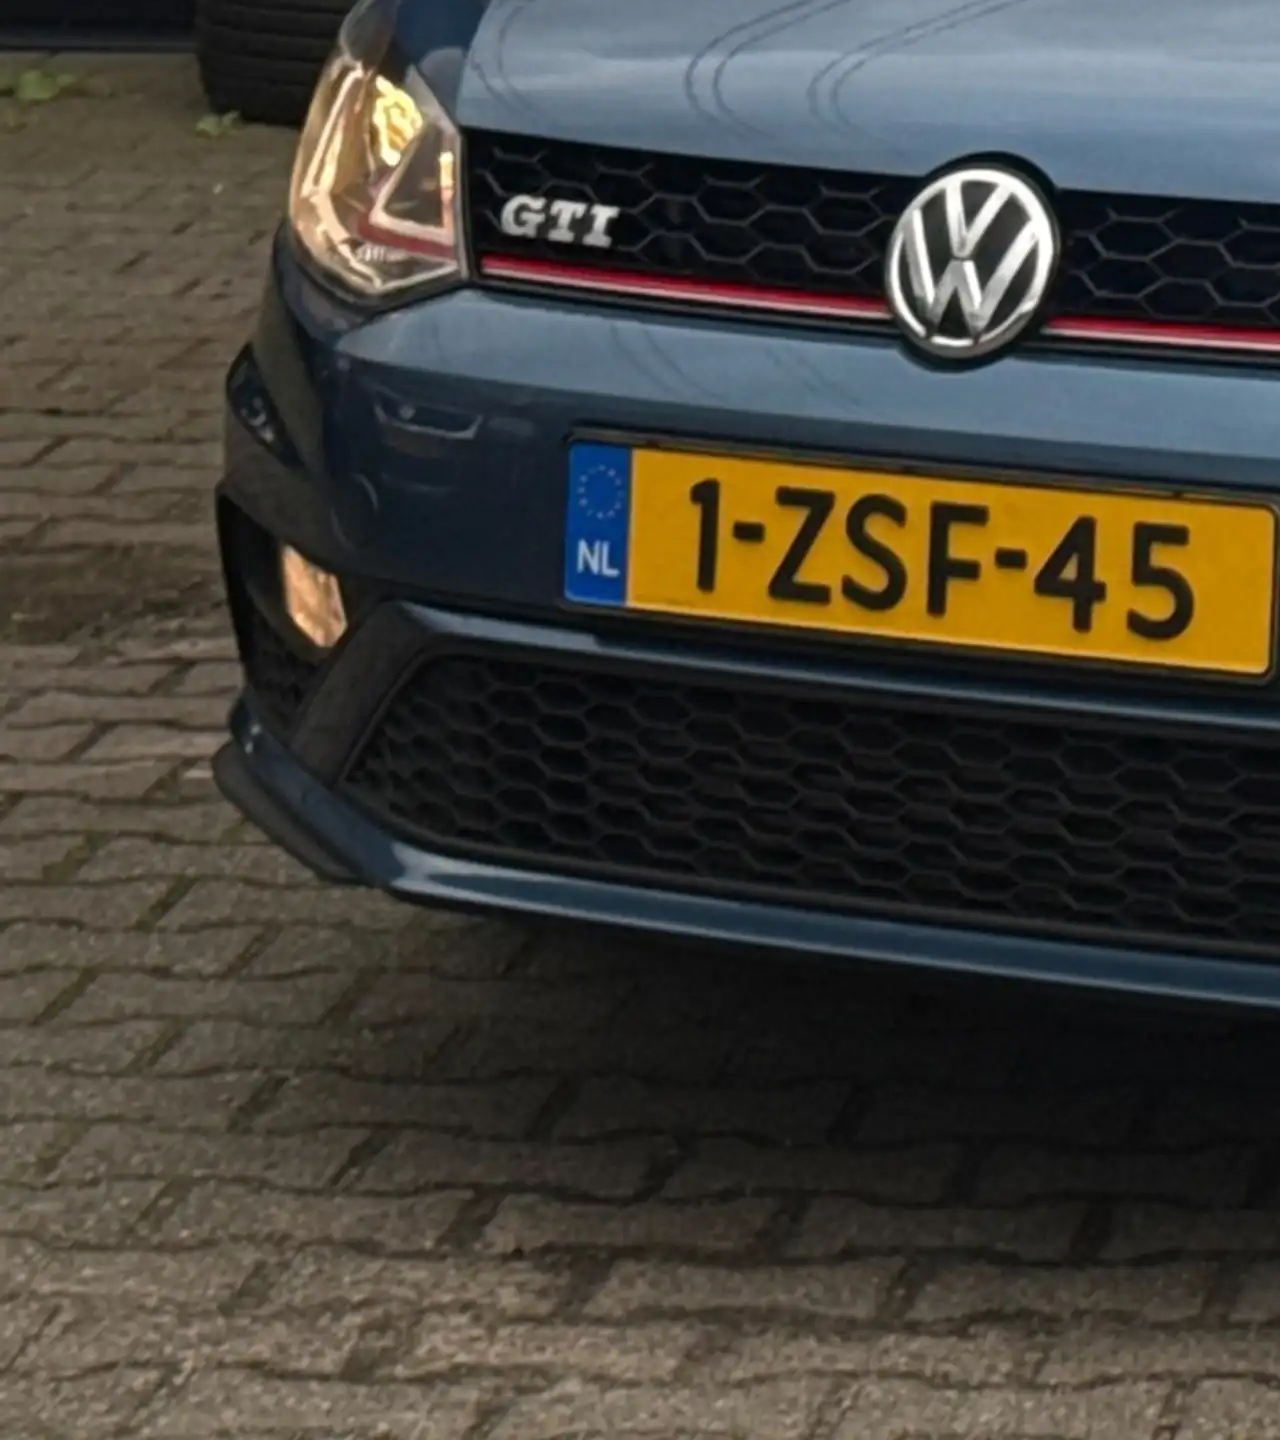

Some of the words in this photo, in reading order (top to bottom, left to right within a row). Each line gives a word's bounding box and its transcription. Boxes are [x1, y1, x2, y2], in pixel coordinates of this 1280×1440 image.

[499, 194, 620, 250] GTI
[575, 537, 621, 579] NL
[689, 477, 1196, 642] 1-ZSF-45
